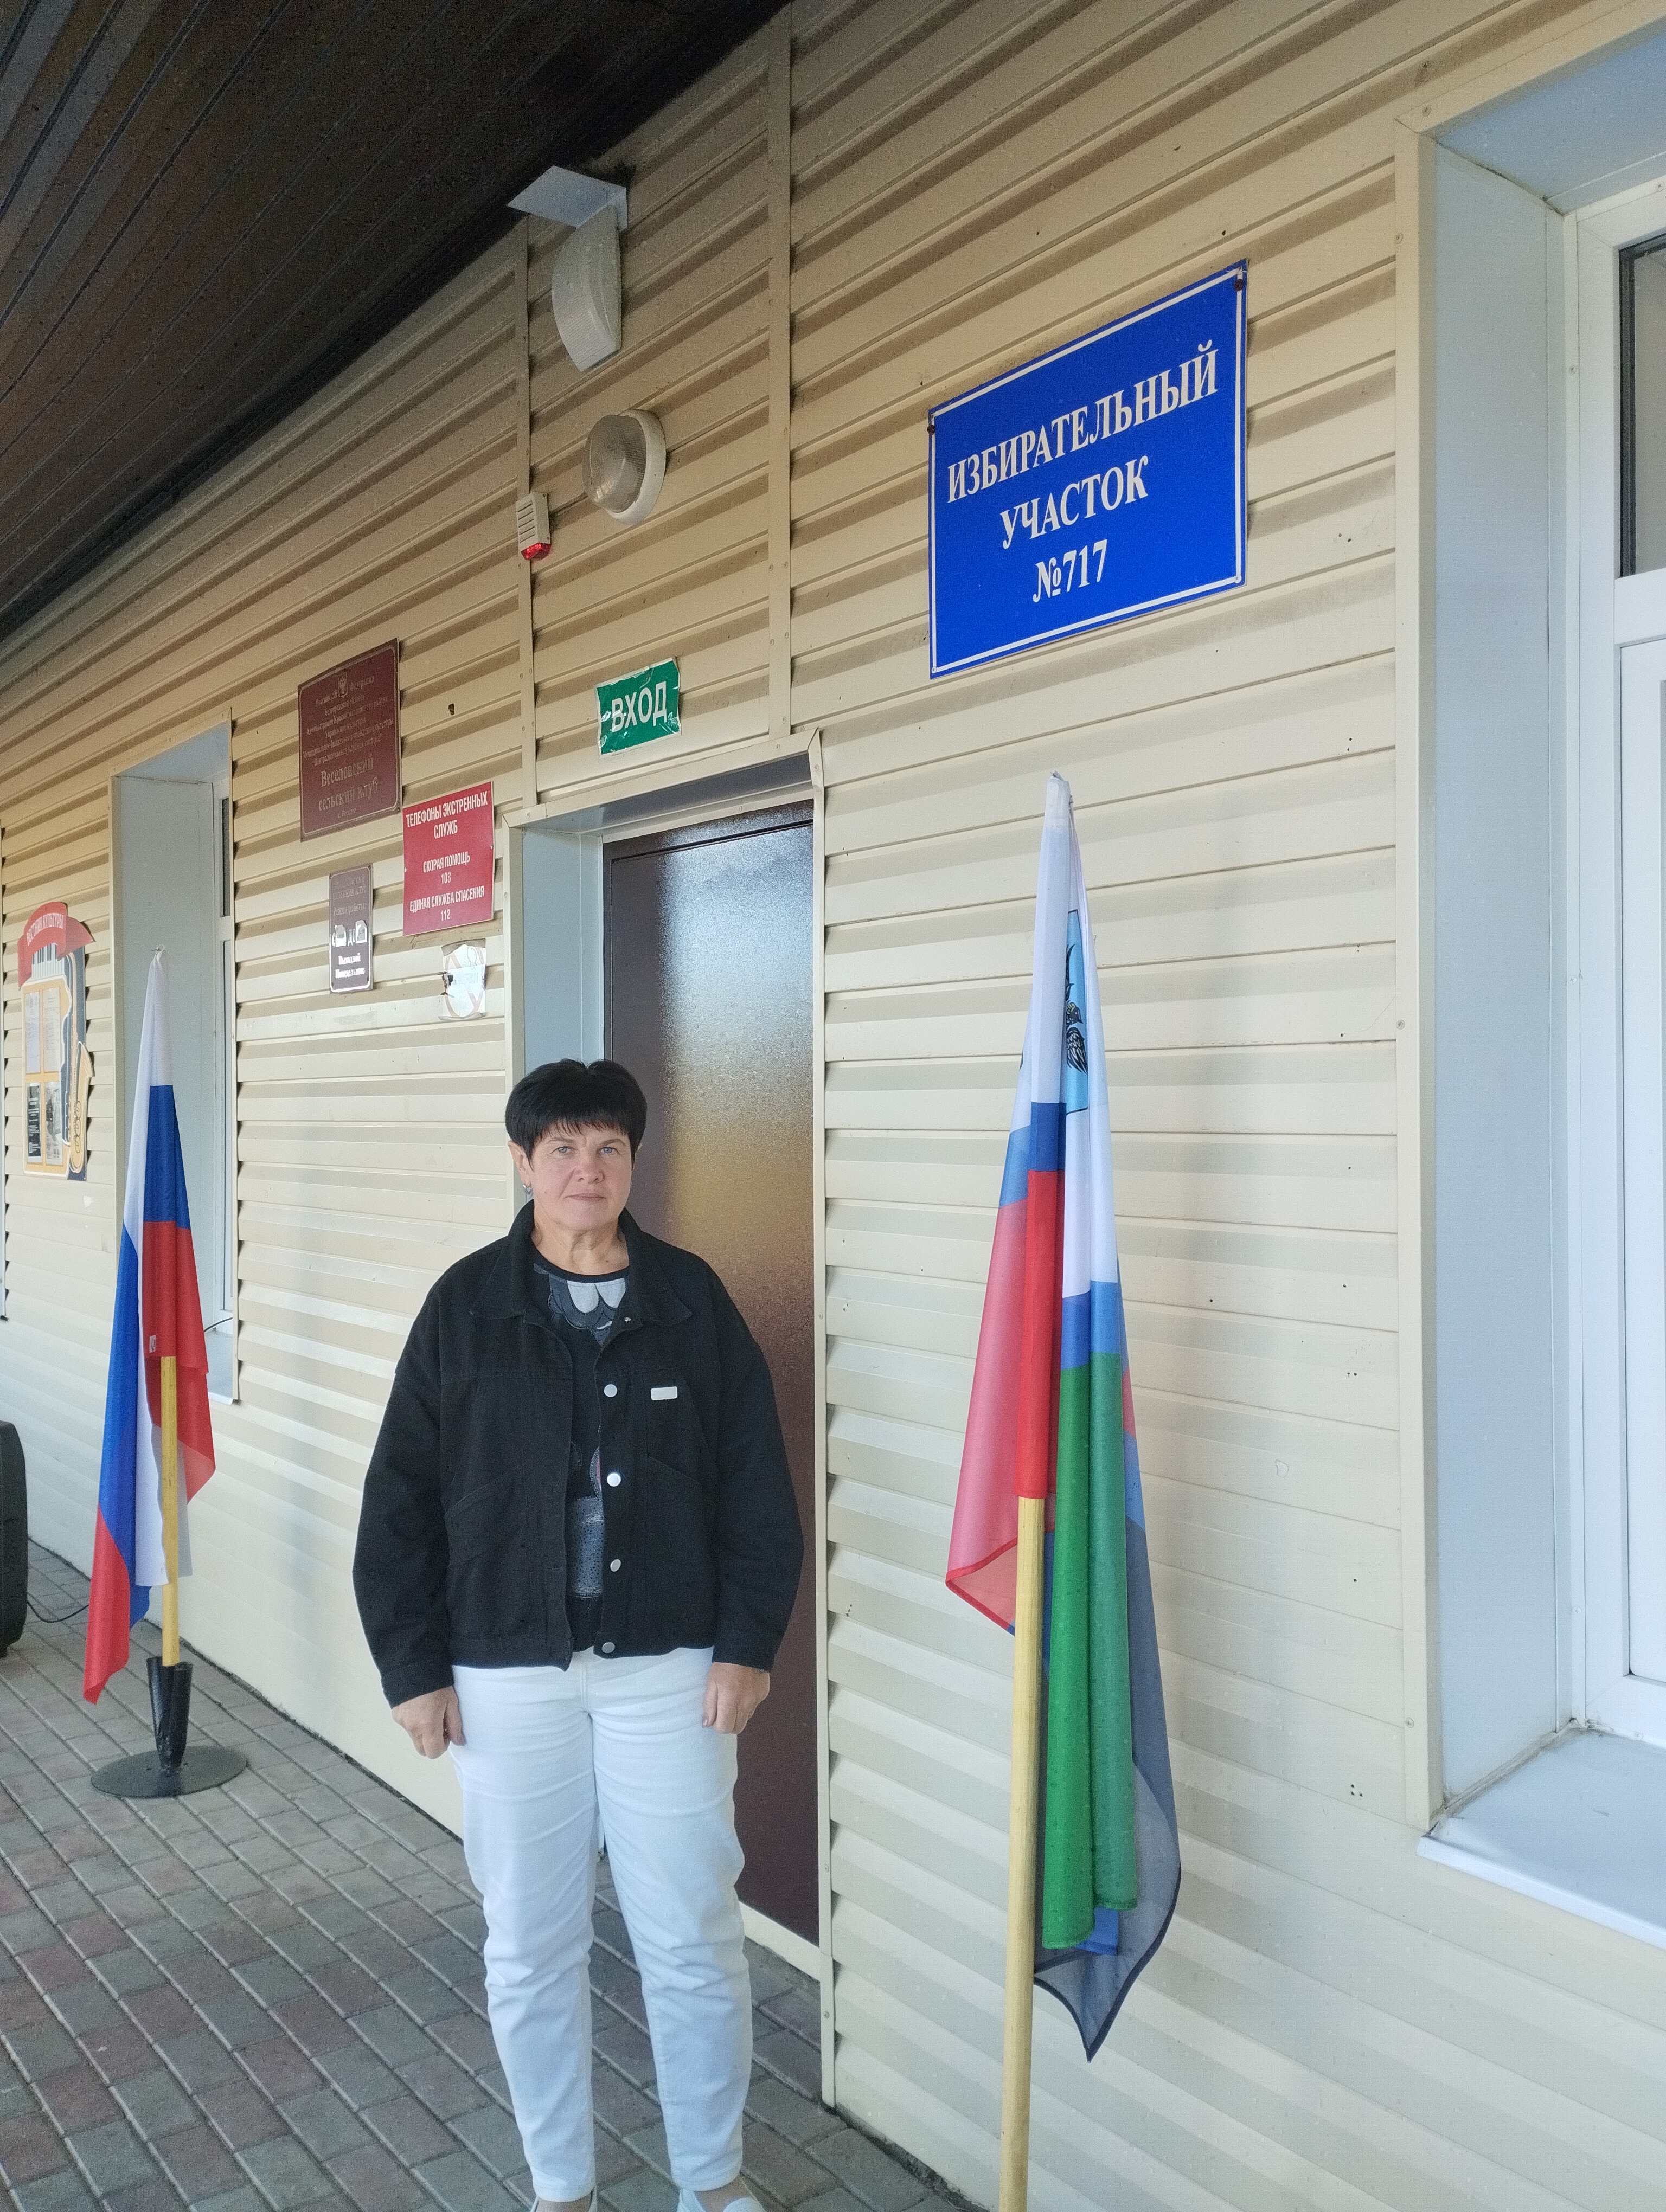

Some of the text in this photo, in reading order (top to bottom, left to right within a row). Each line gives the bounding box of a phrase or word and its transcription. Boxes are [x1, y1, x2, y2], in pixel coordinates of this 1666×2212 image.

[947, 339, 1218, 503] ИЗБИРАТЕЛЬНЫЙ
[1000, 455, 1148, 549] УЧАСТОК
[1033, 539, 1107, 603] №717
[612, 681, 667, 732] ВХОД
[321, 753, 374, 787] Веселовский
[318, 777, 377, 812] сельский клуб
[406, 791, 488, 827] ТЕЛЕФОНЫ ЭКСТРЕННЫХ
[434, 820, 458, 839] СЛУЖБ
[423, 851, 470, 873] СКОРАЯ ПОМОЩЬ
[441, 872, 451, 885] 103
[410, 885, 484, 913] ЕДИНАЯ СЛУЖБА СПАСЕНИЯ
[441, 909, 450, 921] 112
